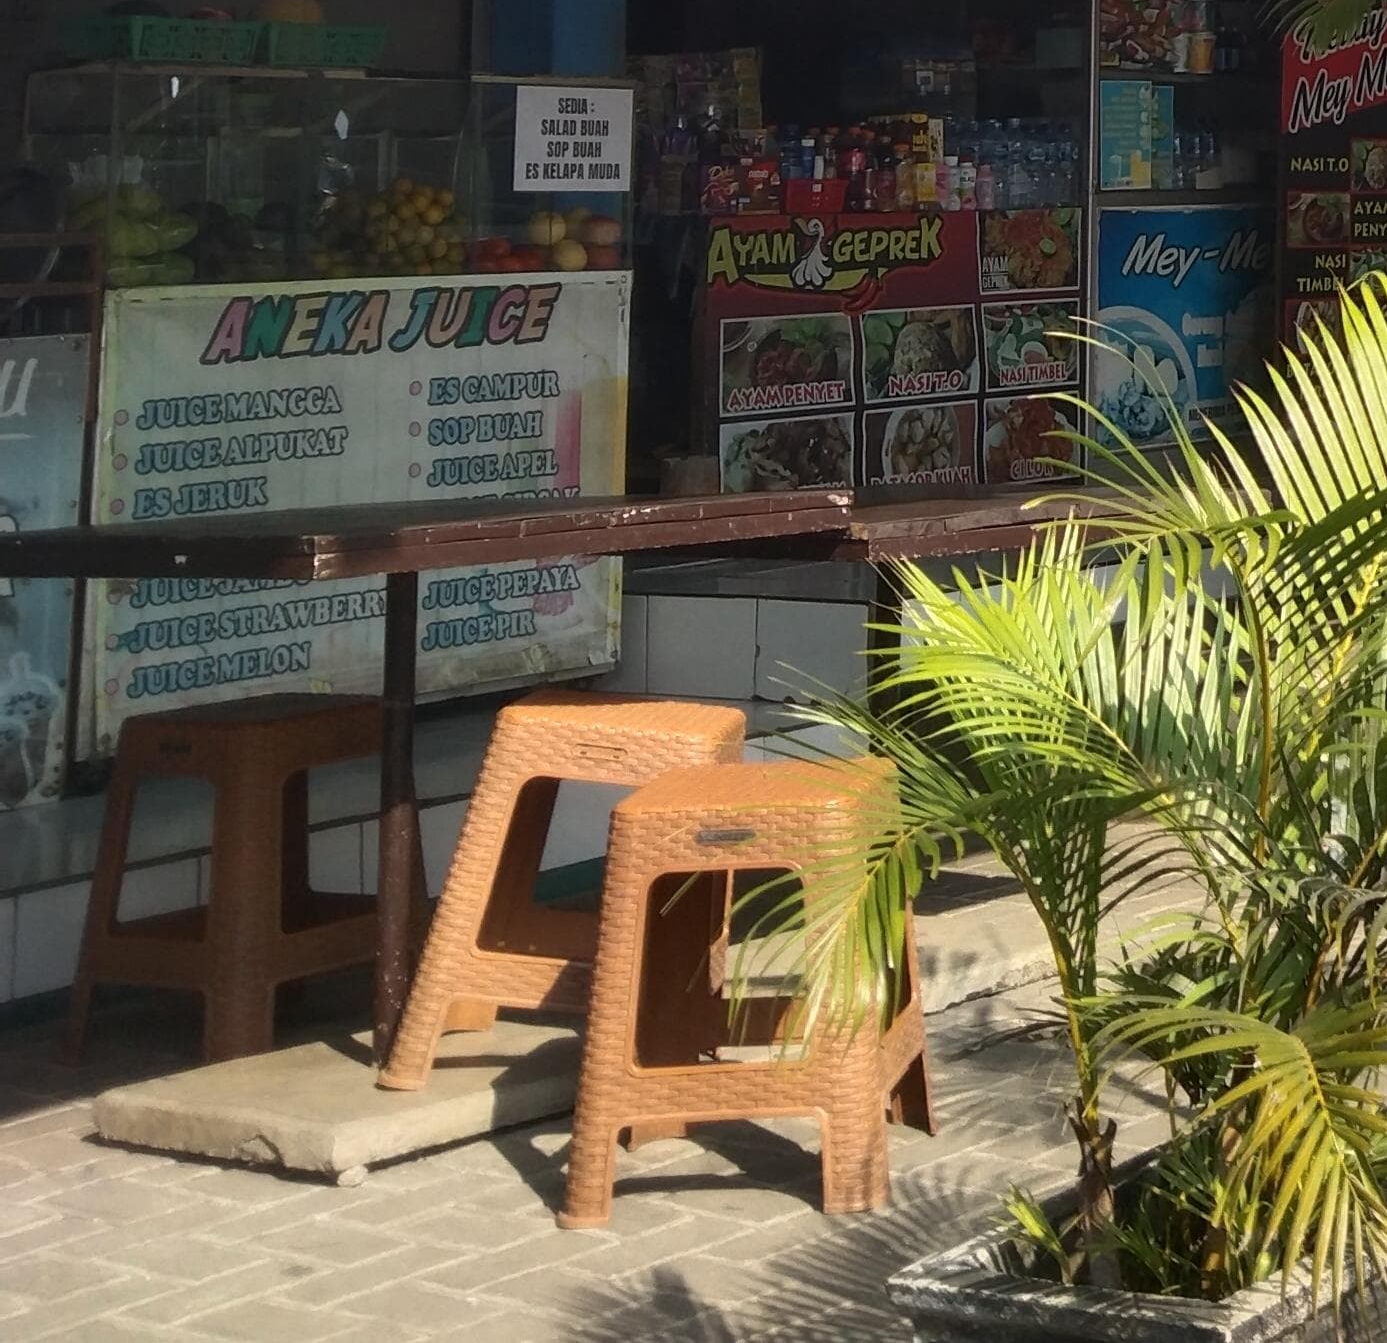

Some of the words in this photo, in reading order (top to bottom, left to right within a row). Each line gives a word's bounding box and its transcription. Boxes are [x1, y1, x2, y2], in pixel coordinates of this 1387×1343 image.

[558, 98, 588, 114] SEDIA
[1288, 68, 1353, 134] Mey
[541, 120, 578, 136] SALAD
[580, 120, 609, 136] BUAH
[547, 141, 570, 157] SOP
[573, 141, 602, 157] BUAH
[1290, 157, 1324, 172] NASI
[525, 163, 539, 179] ES
[543, 163, 584, 179] KELAPA
[588, 163, 621, 179] MUDA
[707, 227, 798, 285] AYAM
[832, 216, 944, 264] GEPREK
[1315, 255, 1347, 269] NASI
[201, 291, 390, 365] ANEKA
[388, 284, 562, 351] JUICE
[427, 377, 461, 406] ES
[462, 369, 560, 404] CAMPUR
[888, 373, 933, 397] NASI
[1000, 363, 1028, 385] NASI
[1028, 361, 1068, 382] TIMBEL
[136, 394, 223, 430] JUICE
[223, 385, 342, 423] MANGGA
[727, 386, 783, 411] AYAM
[784, 380, 845, 406] PENYET
[428, 416, 475, 446] SOP
[476, 410, 544, 442] BUAH
[135, 437, 223, 475] JUICE
[222, 426, 348, 467] ALPUKAT
[427, 454, 498, 487] JUICE
[500, 449, 559, 481] APEL
[132, 487, 172, 520] ES
[173, 476, 269, 514] JERUK
[130, 578, 216, 608] JUICE
[422, 574, 496, 610] JUICE
[496, 564, 580, 600] PEPAYA
[127, 612, 217, 654] JUICE
[422, 614, 494, 651] JUICE
[494, 609, 537, 641] PIR
[126, 655, 217, 699] JUICE
[216, 640, 312, 684] MELON
